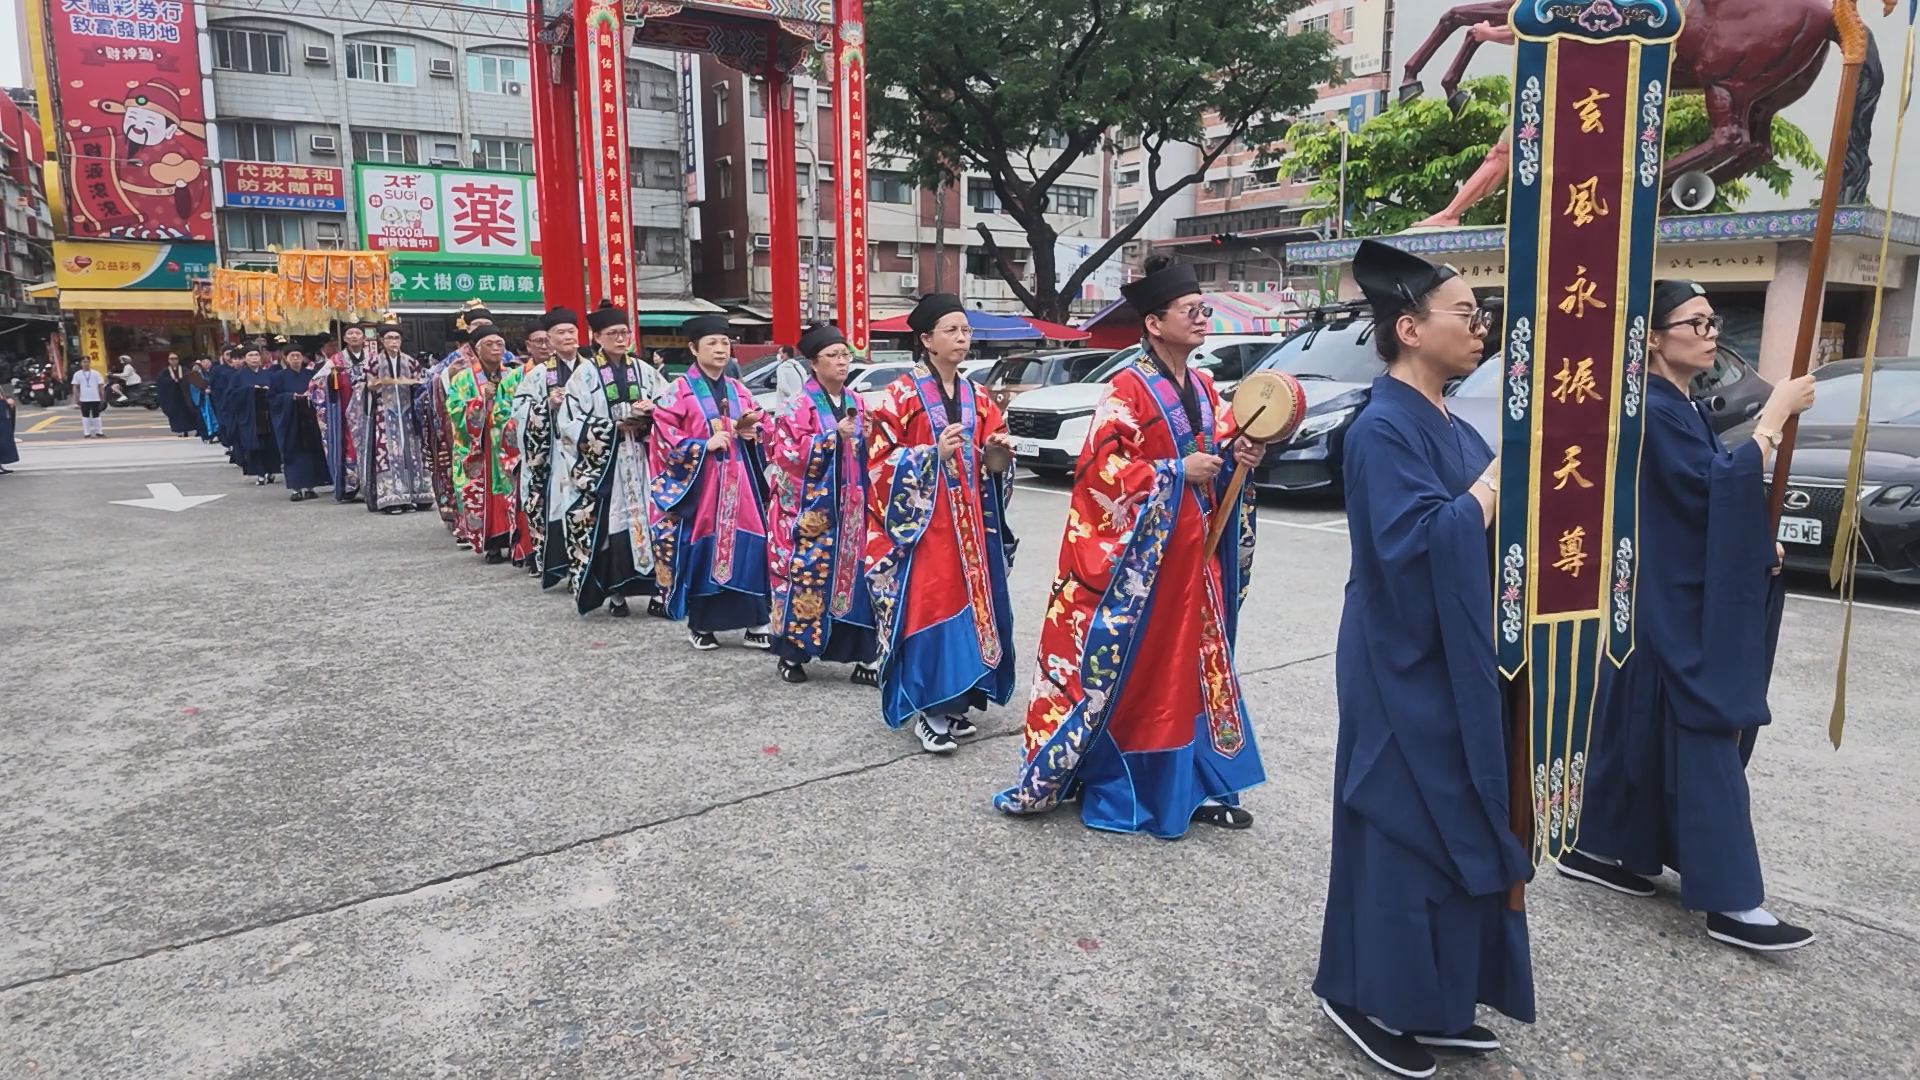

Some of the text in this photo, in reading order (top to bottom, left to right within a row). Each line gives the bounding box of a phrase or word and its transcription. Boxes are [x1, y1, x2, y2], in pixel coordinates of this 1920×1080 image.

[71, 15, 179, 42] 致富發財地
[237, 178, 334, 196] 防水閘門
[384, 174, 421, 188] スギ
[240, 195, 336, 209] 07-7874678
[96, 261, 141, 272] 公益彩券
[411, 273, 452, 291] 大樹
[1551, 88, 1610, 577] 玄風永振天尊
